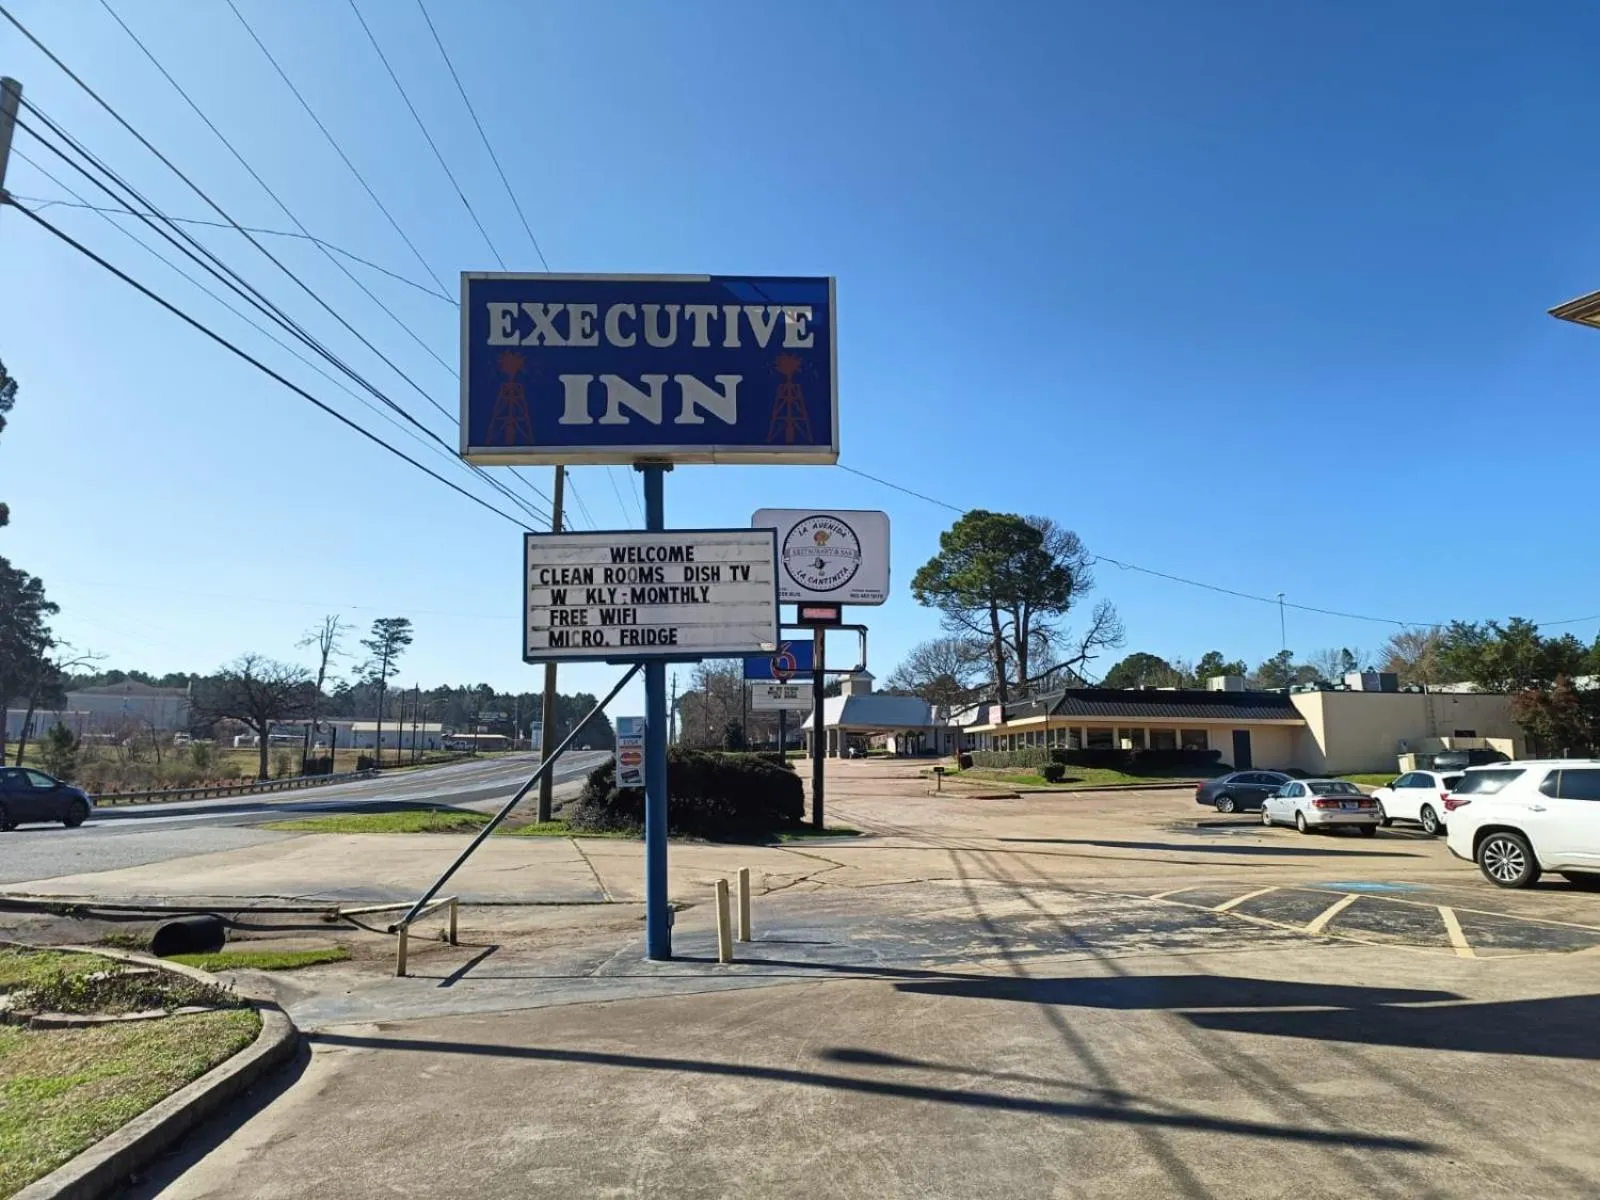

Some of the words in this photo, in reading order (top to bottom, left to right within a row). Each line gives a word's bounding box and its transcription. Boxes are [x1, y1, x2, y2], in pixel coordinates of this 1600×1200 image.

[486, 302, 814, 349] EXECUTIVE
[558, 373, 743, 425] INN
[798, 526, 809, 537] LA
[610, 545, 695, 564] WELCOME
[540, 567, 594, 585] CLEAN
[604, 566, 665, 584] ROOMS
[683, 565, 721, 582] DISH
[729, 565, 751, 581] TV
[550, 608, 589, 626] FREE
[599, 608, 637, 626] WIFI
[620, 628, 678, 646] FRIDGE
